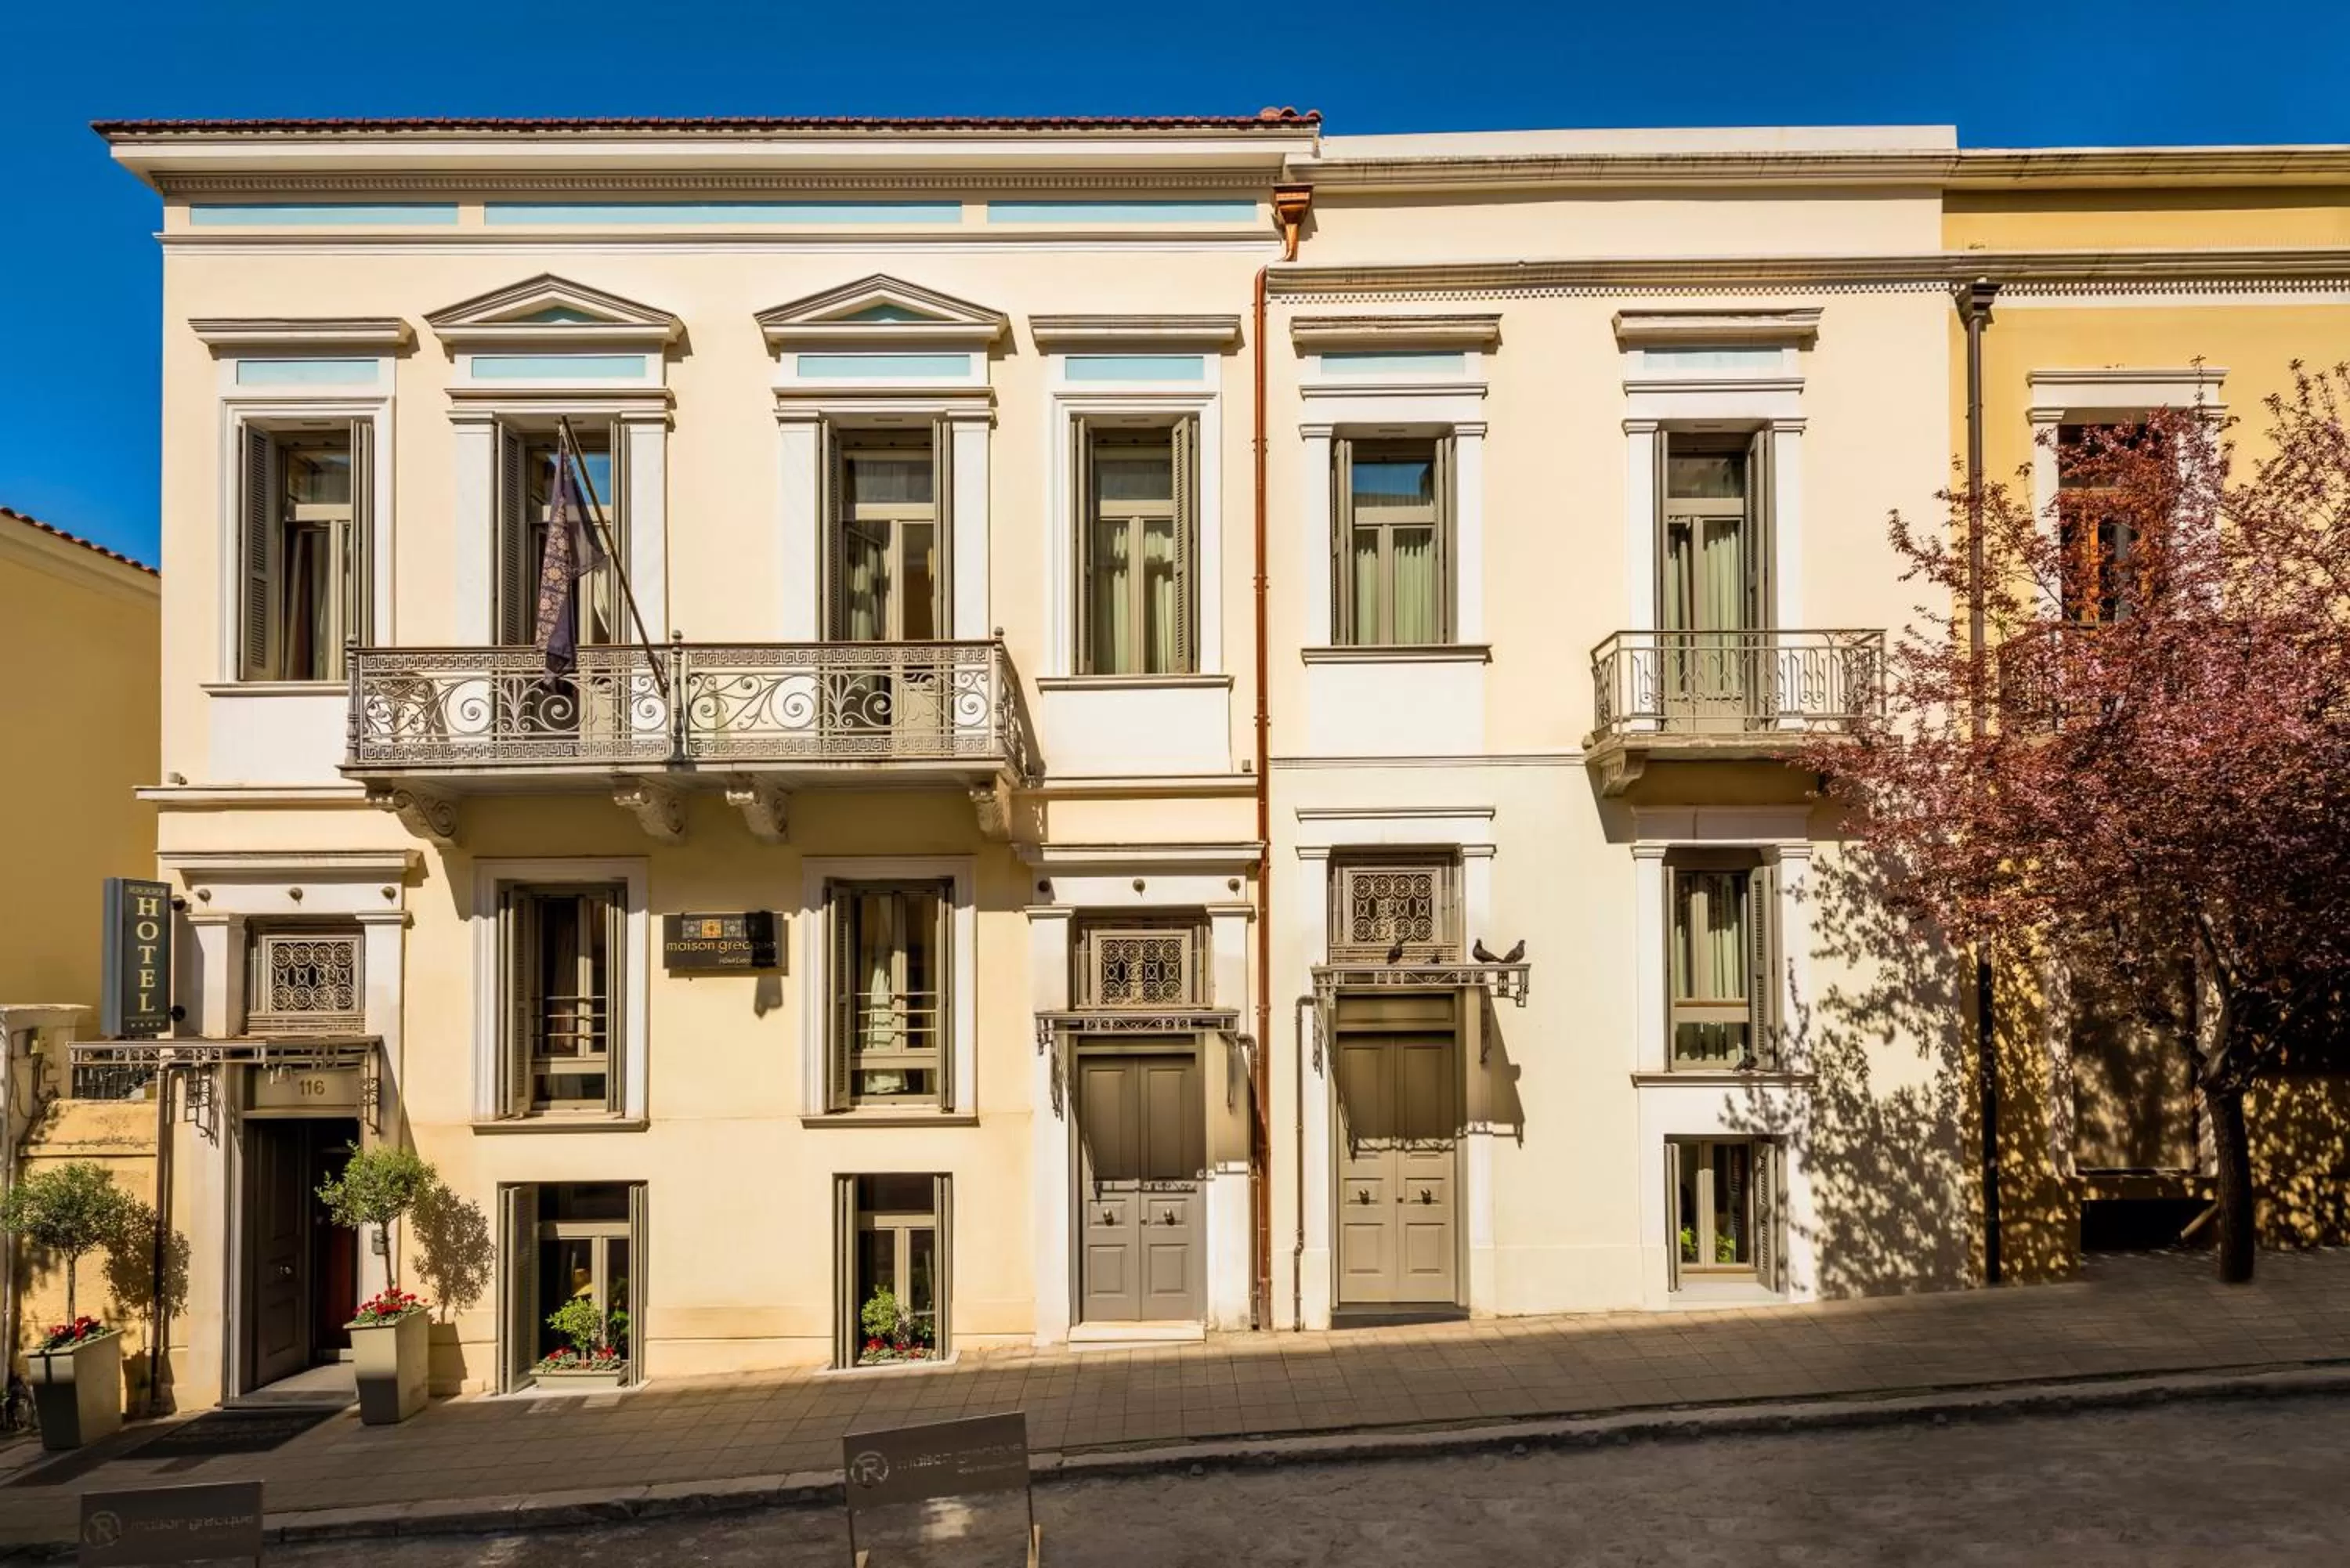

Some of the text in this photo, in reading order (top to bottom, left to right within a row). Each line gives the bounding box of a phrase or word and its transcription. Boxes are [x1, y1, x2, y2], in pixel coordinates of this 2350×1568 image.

[136, 897, 159, 1012] HOTEL
[666, 940, 715, 952] maison
[299, 1079, 325, 1096] 116
